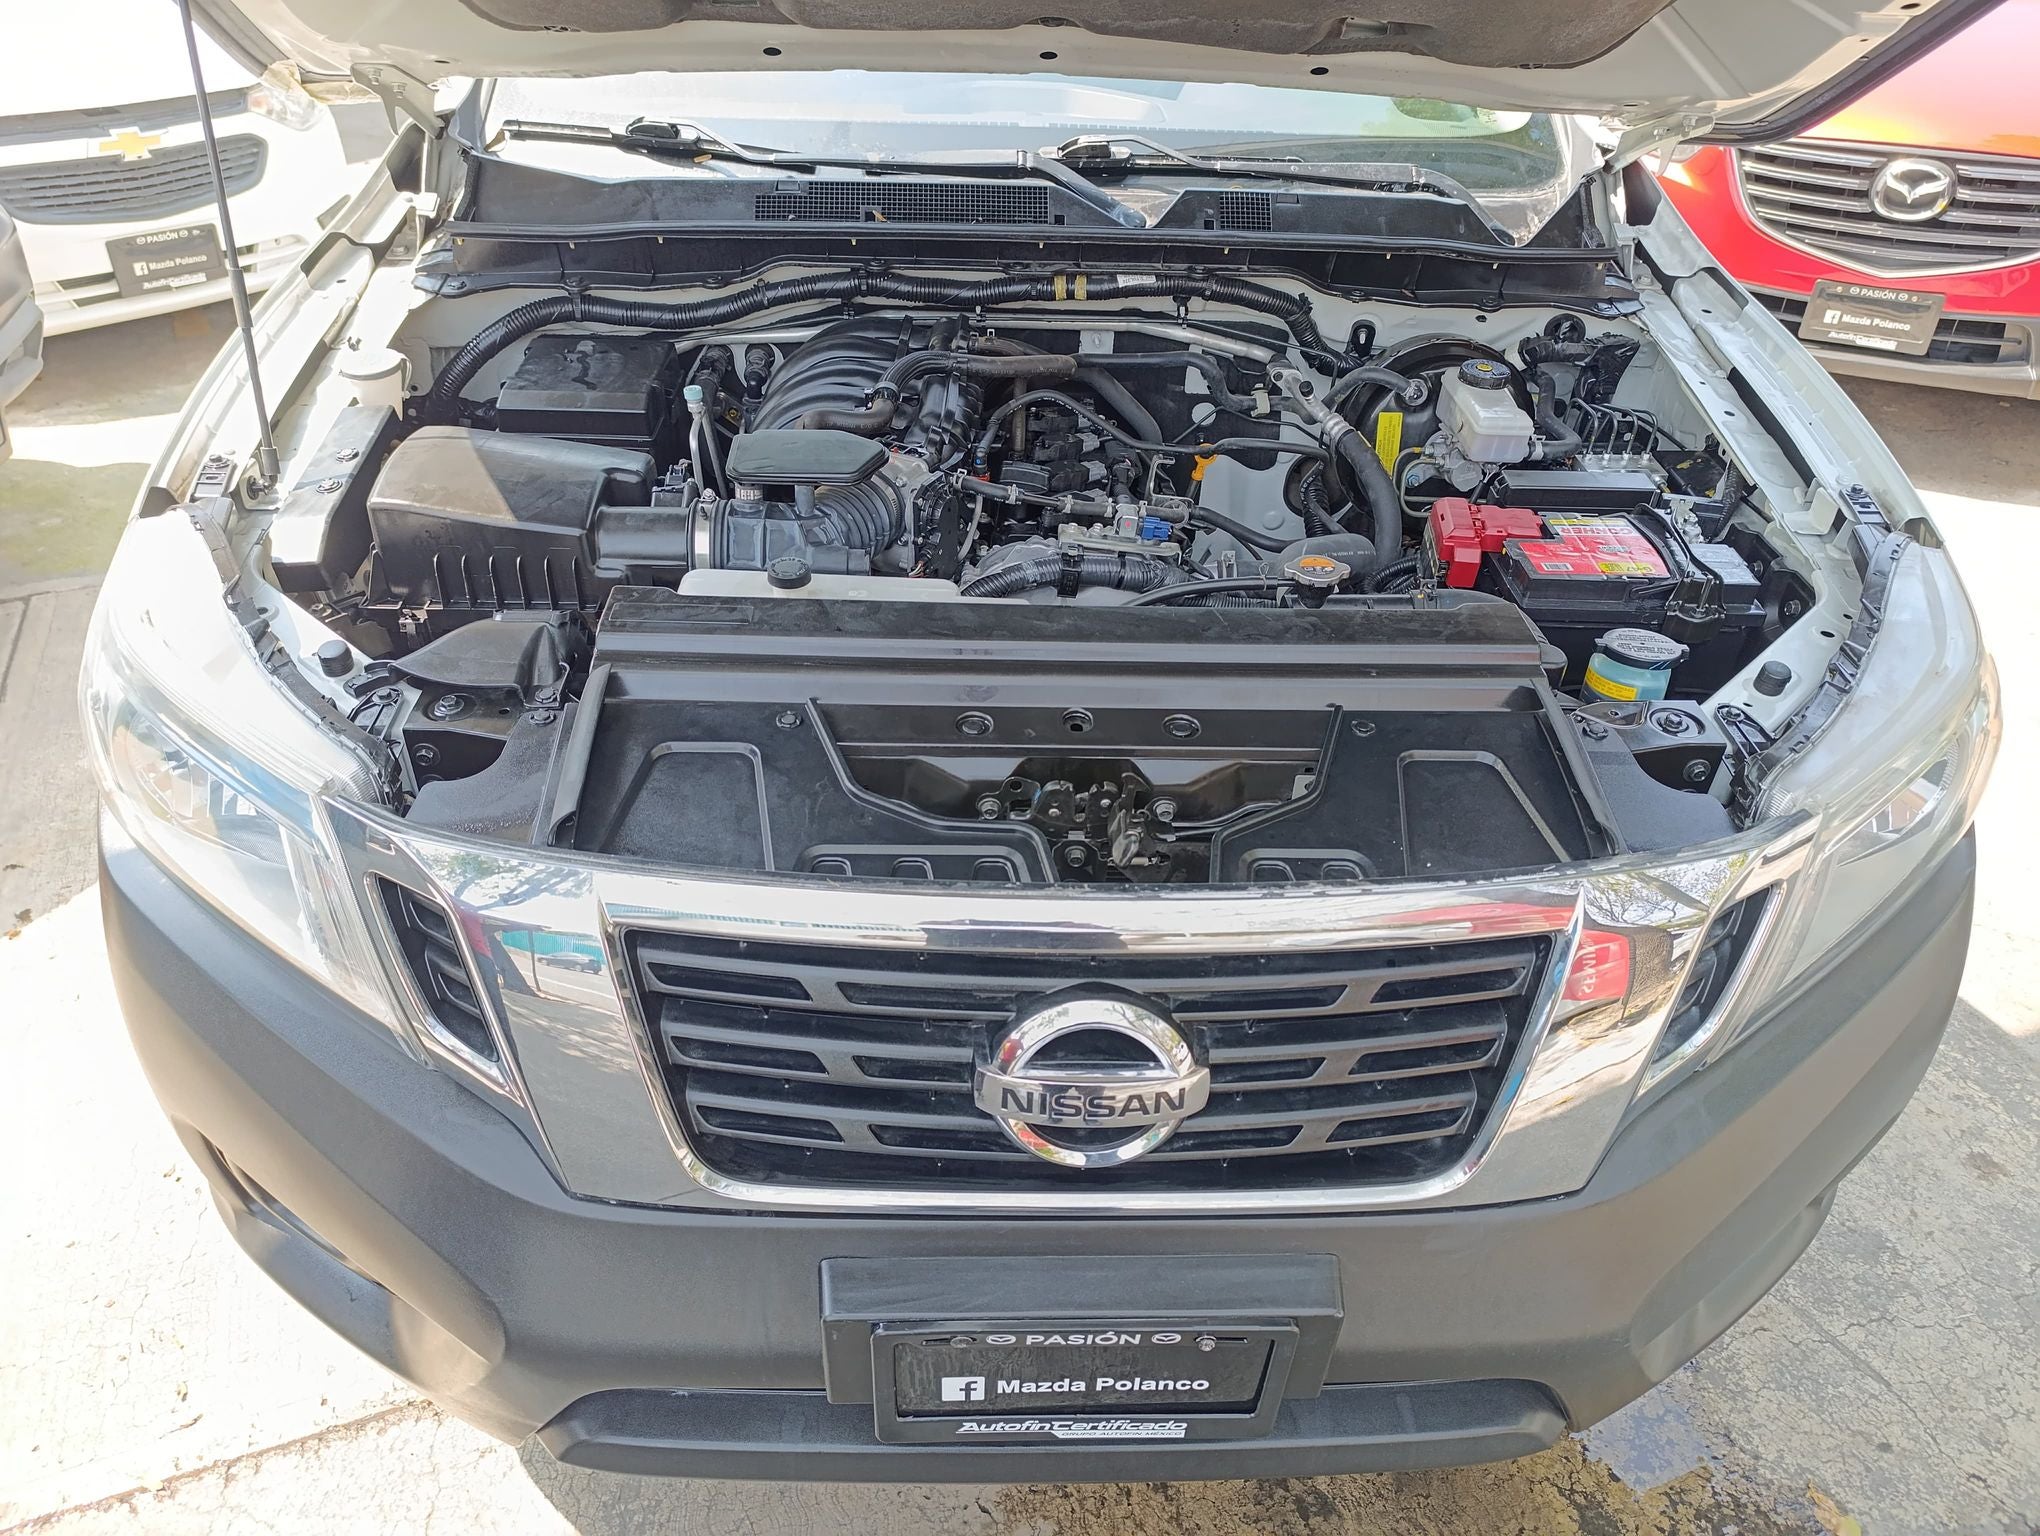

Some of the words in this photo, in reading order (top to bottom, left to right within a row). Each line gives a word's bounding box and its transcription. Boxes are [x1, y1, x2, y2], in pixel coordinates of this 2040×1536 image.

[147, 231, 179, 244] PASIÓN
[149, 260, 175, 271] Mazda
[175, 255, 207, 266] Polanco
[1860, 286, 1897, 300] PASIÓN
[1842, 314, 1871, 327] Mazda
[1872, 318, 1911, 331] Polanco
[1001, 1087, 1187, 1119] NISSAN
[1026, 1331, 1142, 1346] PASIÓN
[997, 1378, 1087, 1394] Mazda
[1095, 1376, 1210, 1392] Polanco
